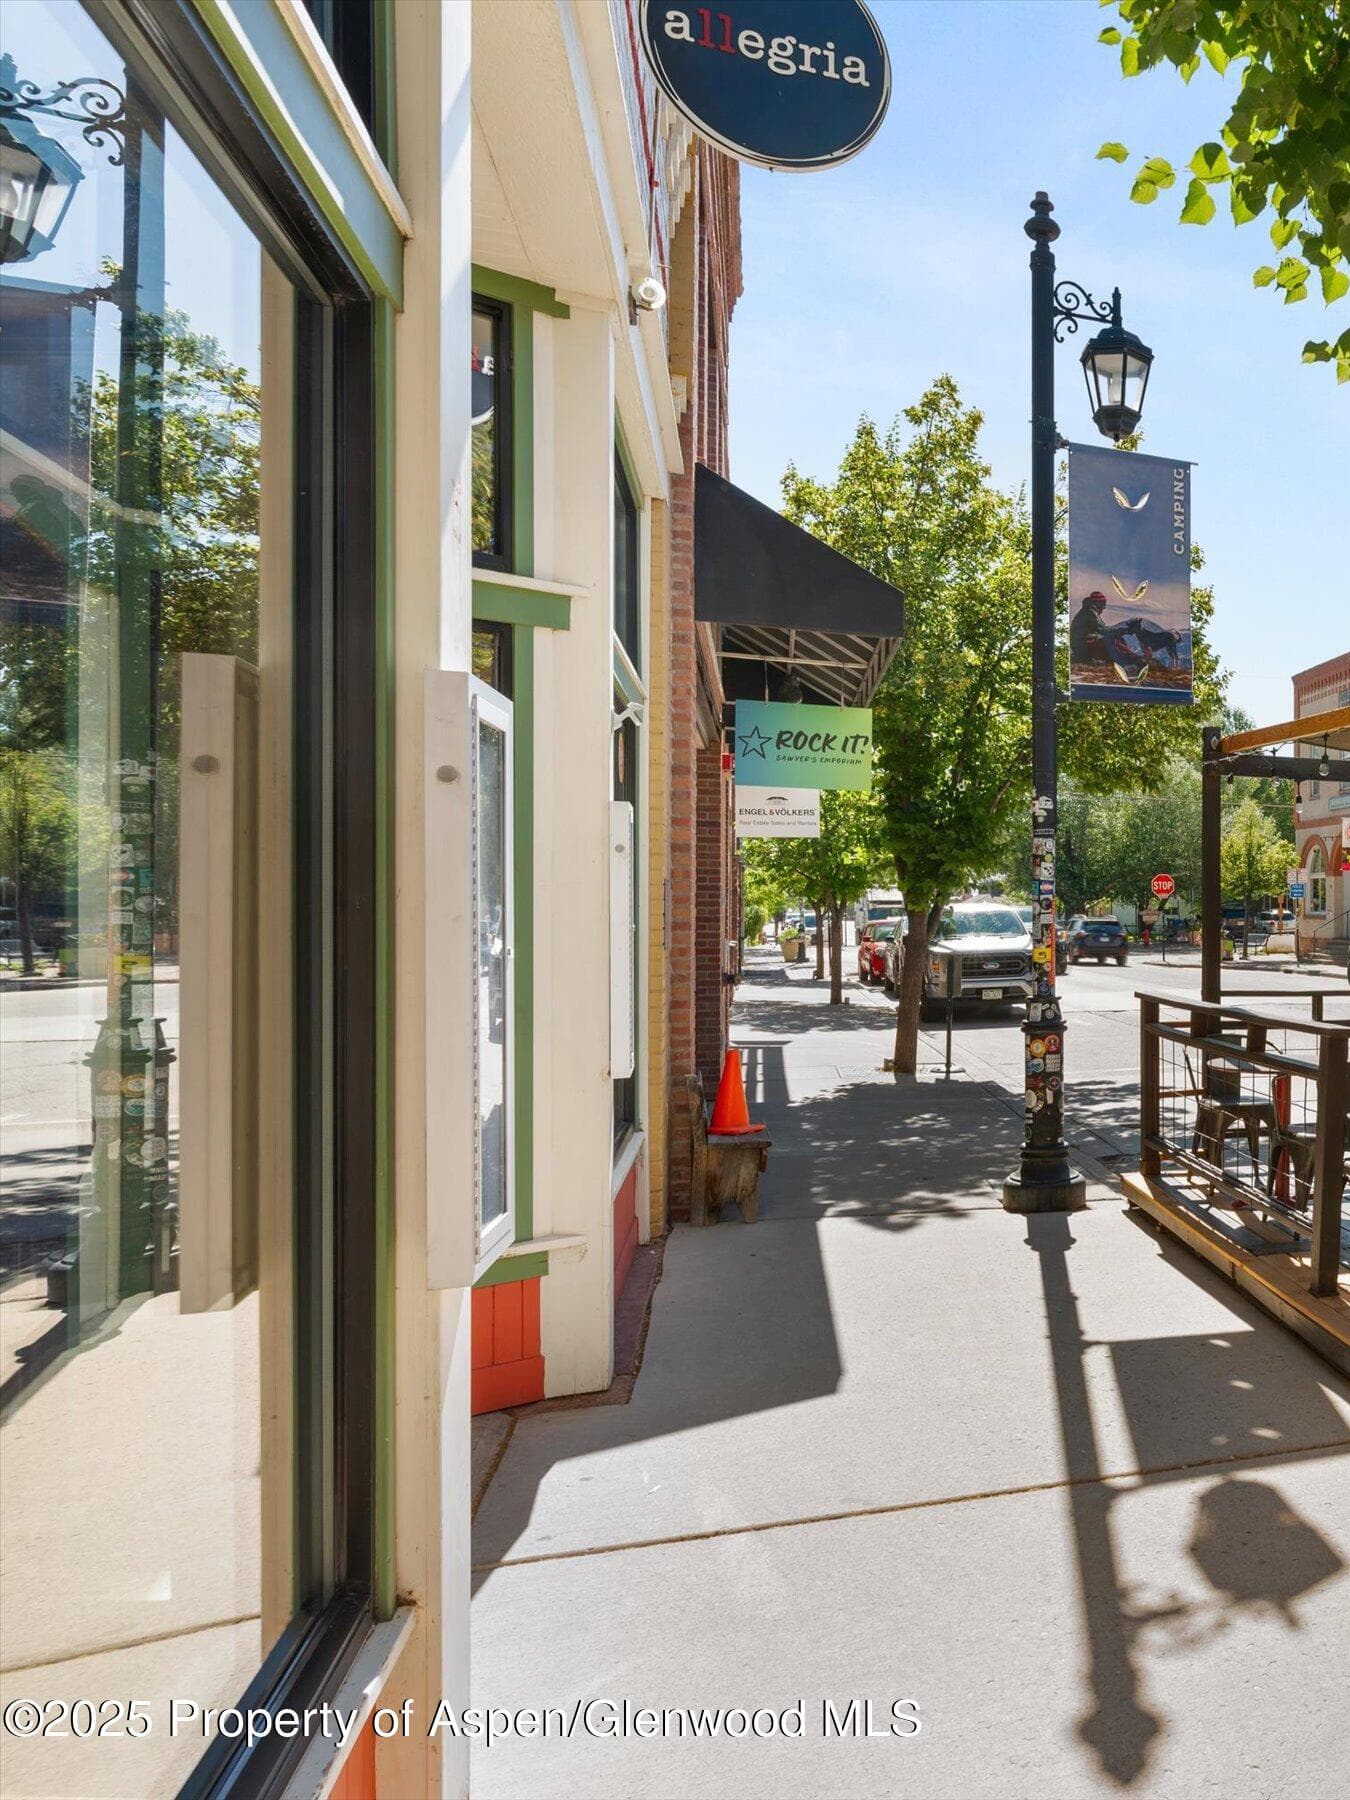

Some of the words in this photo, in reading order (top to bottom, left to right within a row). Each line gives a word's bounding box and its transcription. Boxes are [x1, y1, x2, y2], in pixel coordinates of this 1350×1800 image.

[664, 7, 870, 87] allegria
[1173, 468, 1185, 555] CAMPING
[776, 730, 837, 752] ROCK
[841, 733, 869, 754] IT!
[820, 757, 862, 765] EMPORIUM
[1153, 881, 1173, 891] STOP
